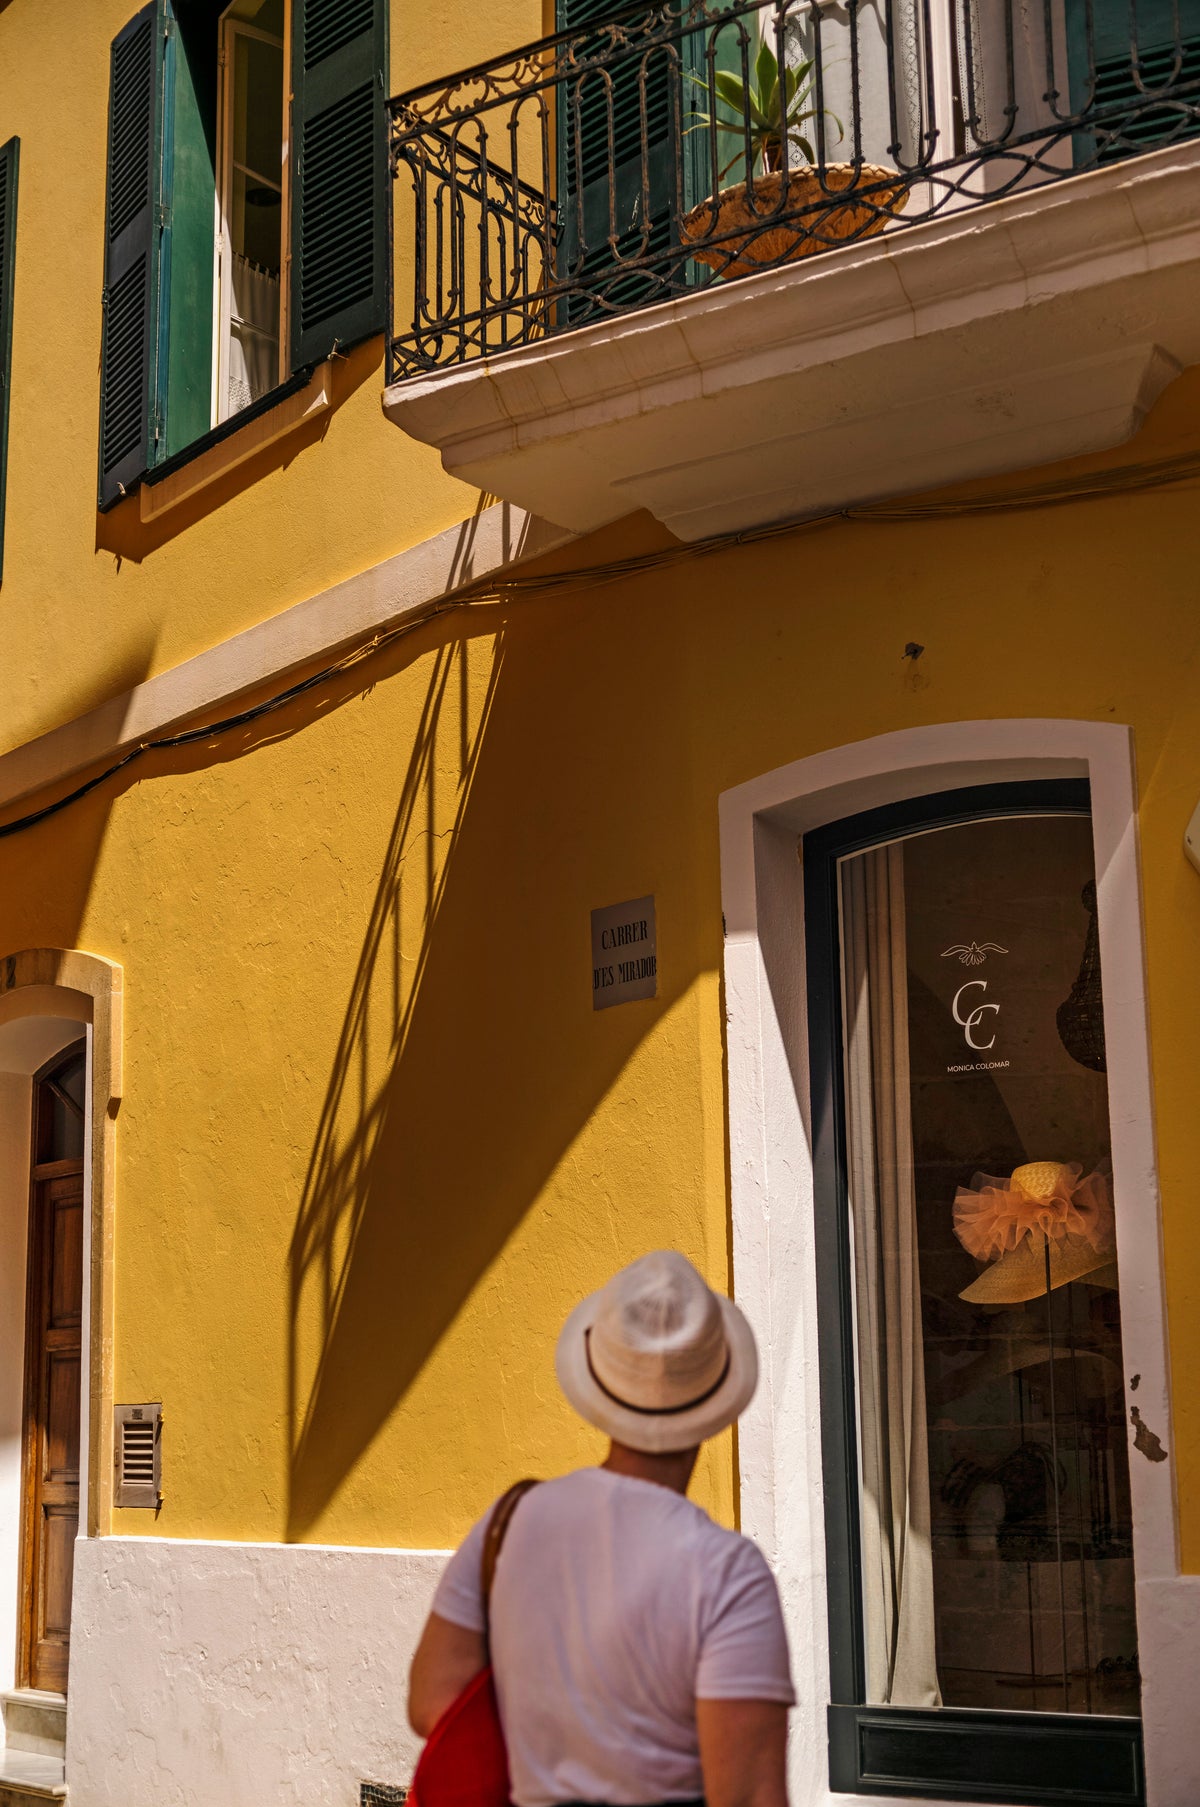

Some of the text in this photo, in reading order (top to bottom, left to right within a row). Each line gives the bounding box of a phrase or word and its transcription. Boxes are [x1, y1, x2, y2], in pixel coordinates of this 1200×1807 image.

[601, 920, 648, 950] CARRER
[618, 956, 657, 985] MIRADOR
[947, 1060, 1010, 1073] MONICA COLOMAR
